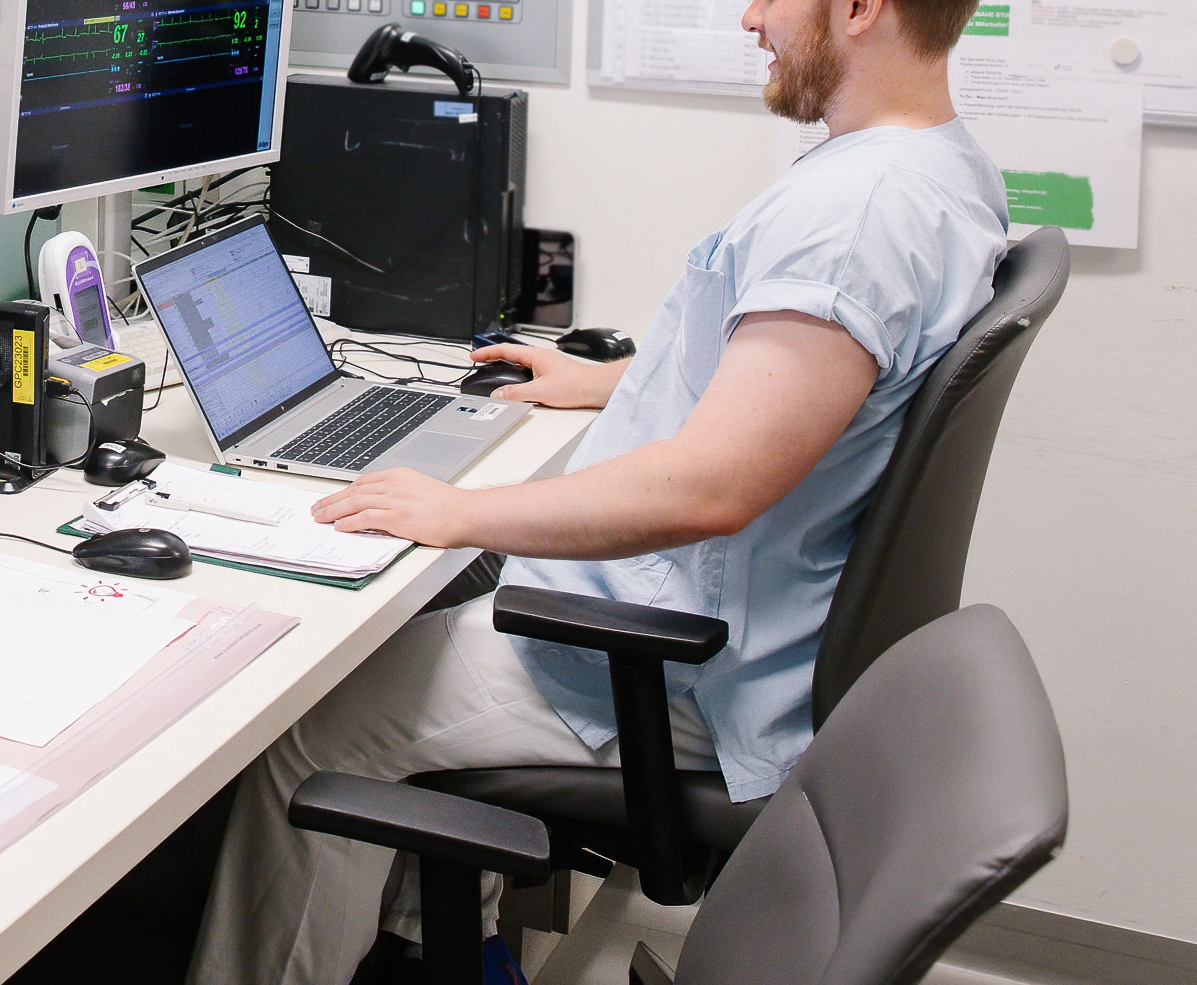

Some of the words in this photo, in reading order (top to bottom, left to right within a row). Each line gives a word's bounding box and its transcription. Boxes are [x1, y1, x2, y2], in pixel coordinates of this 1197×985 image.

[233, 11, 247, 29] 92
[254, 19, 259, 29] 2
[113, 24, 129, 44] 67
[137, 32, 145, 43] 27
[14, 335, 23, 389] GPC23023
